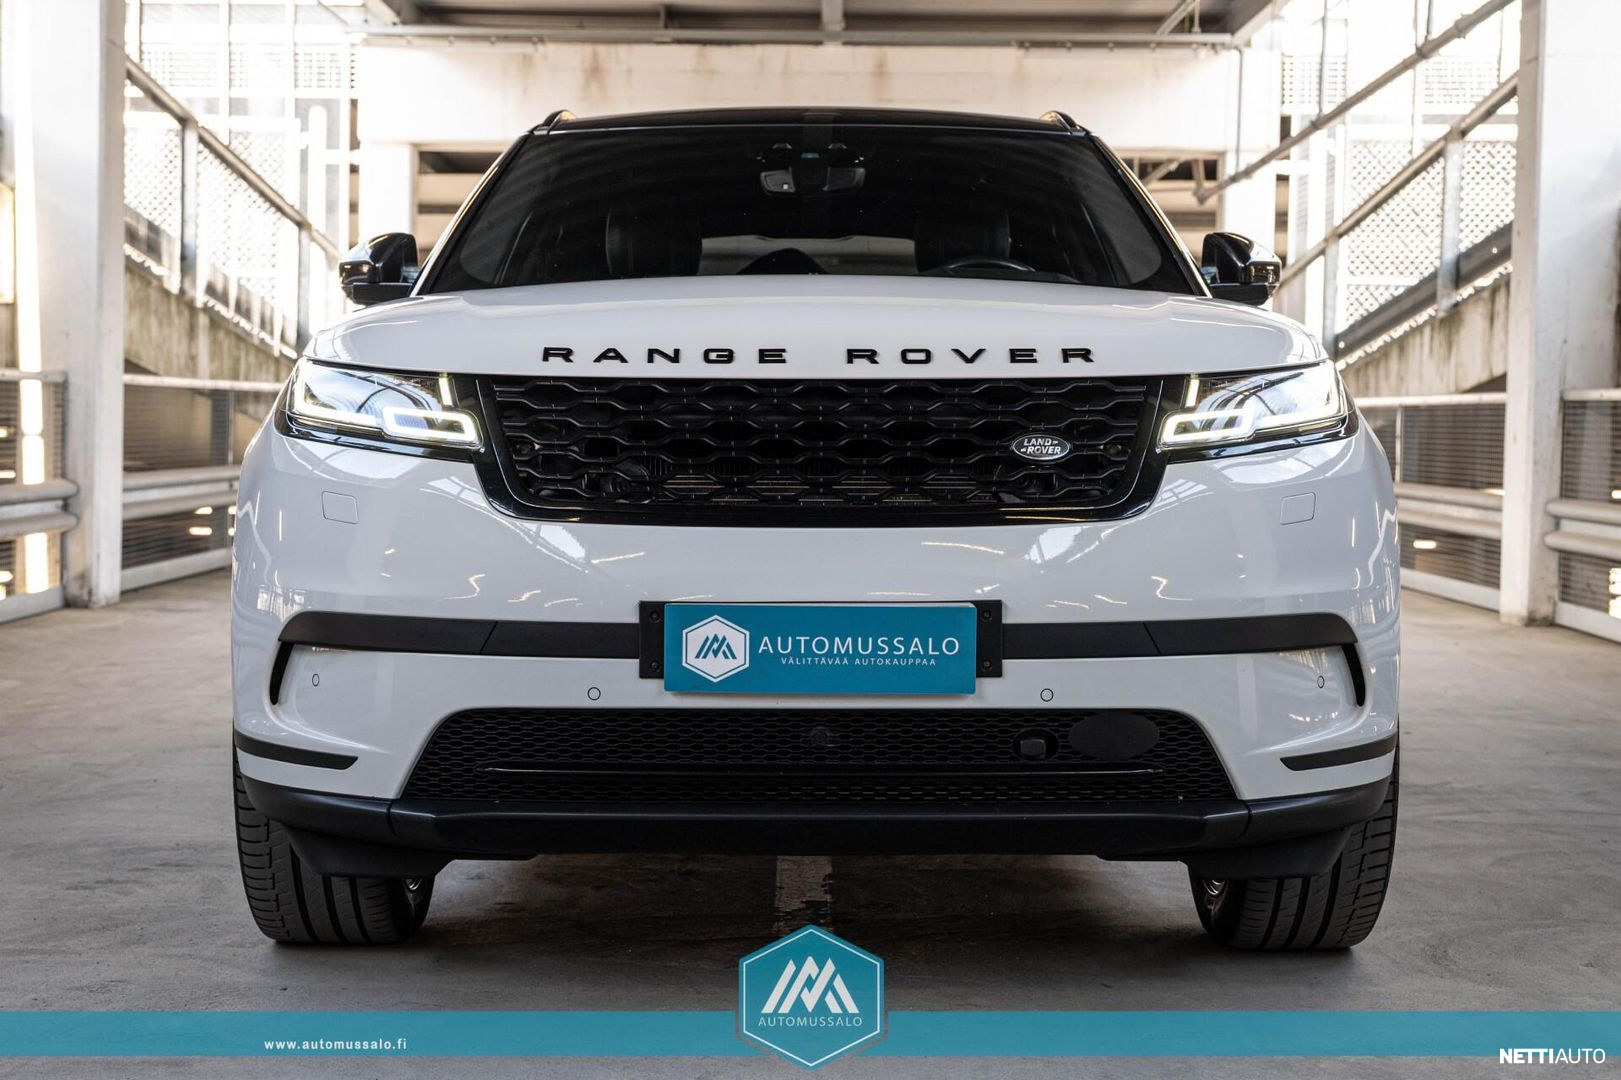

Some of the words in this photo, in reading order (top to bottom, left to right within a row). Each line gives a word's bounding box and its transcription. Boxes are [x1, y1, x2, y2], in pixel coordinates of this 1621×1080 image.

[542, 346, 788, 364] RANGE
[846, 347, 1095, 365] ROVER
[1023, 438, 1052, 446] LAND
[1026, 446, 1061, 454] ROVER
[758, 635, 960, 655] AUTOMUSSALO
[781, 656, 849, 666] VÄLITTÄVÄÄ
[854, 658, 937, 666] AUTOKAUPPAA
